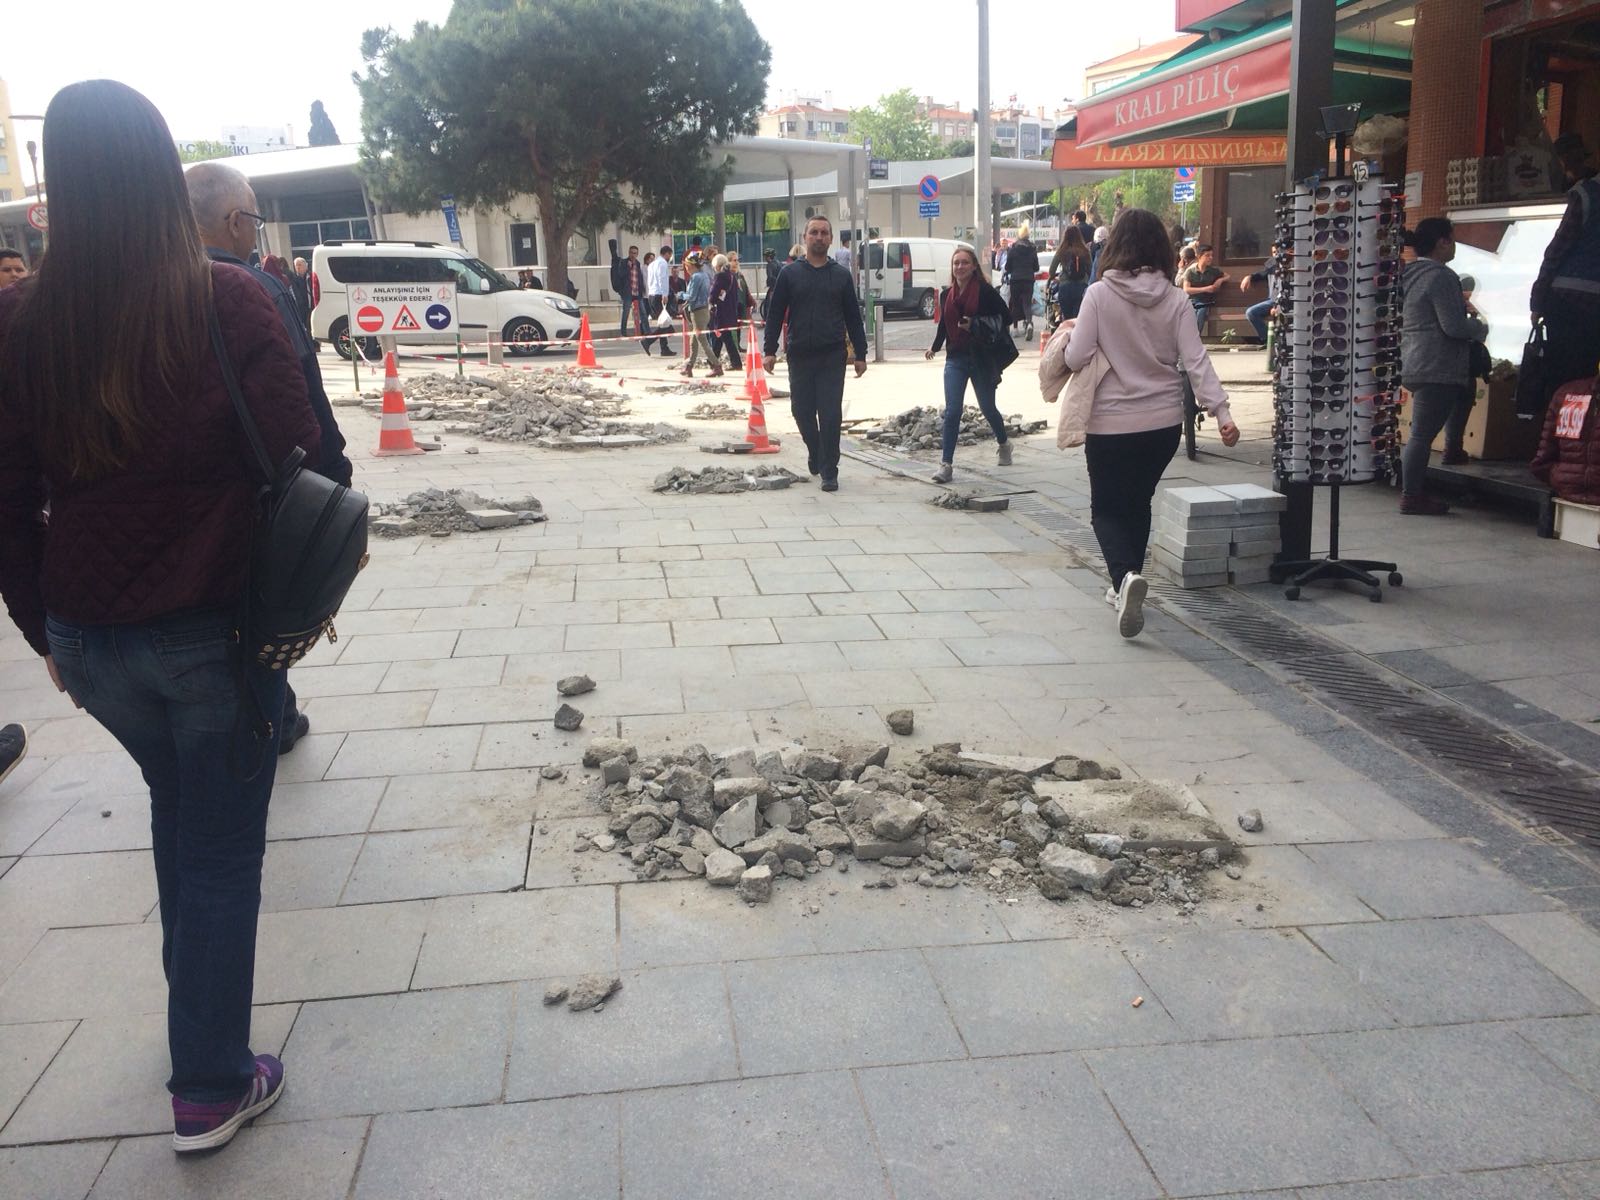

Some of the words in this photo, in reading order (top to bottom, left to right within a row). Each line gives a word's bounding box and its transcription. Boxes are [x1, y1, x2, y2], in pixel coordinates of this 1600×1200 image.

[1114, 90, 1166, 127] KRAL
[1171, 64, 1240, 110] PİLİÇ
[1353, 162, 1368, 182] 15
